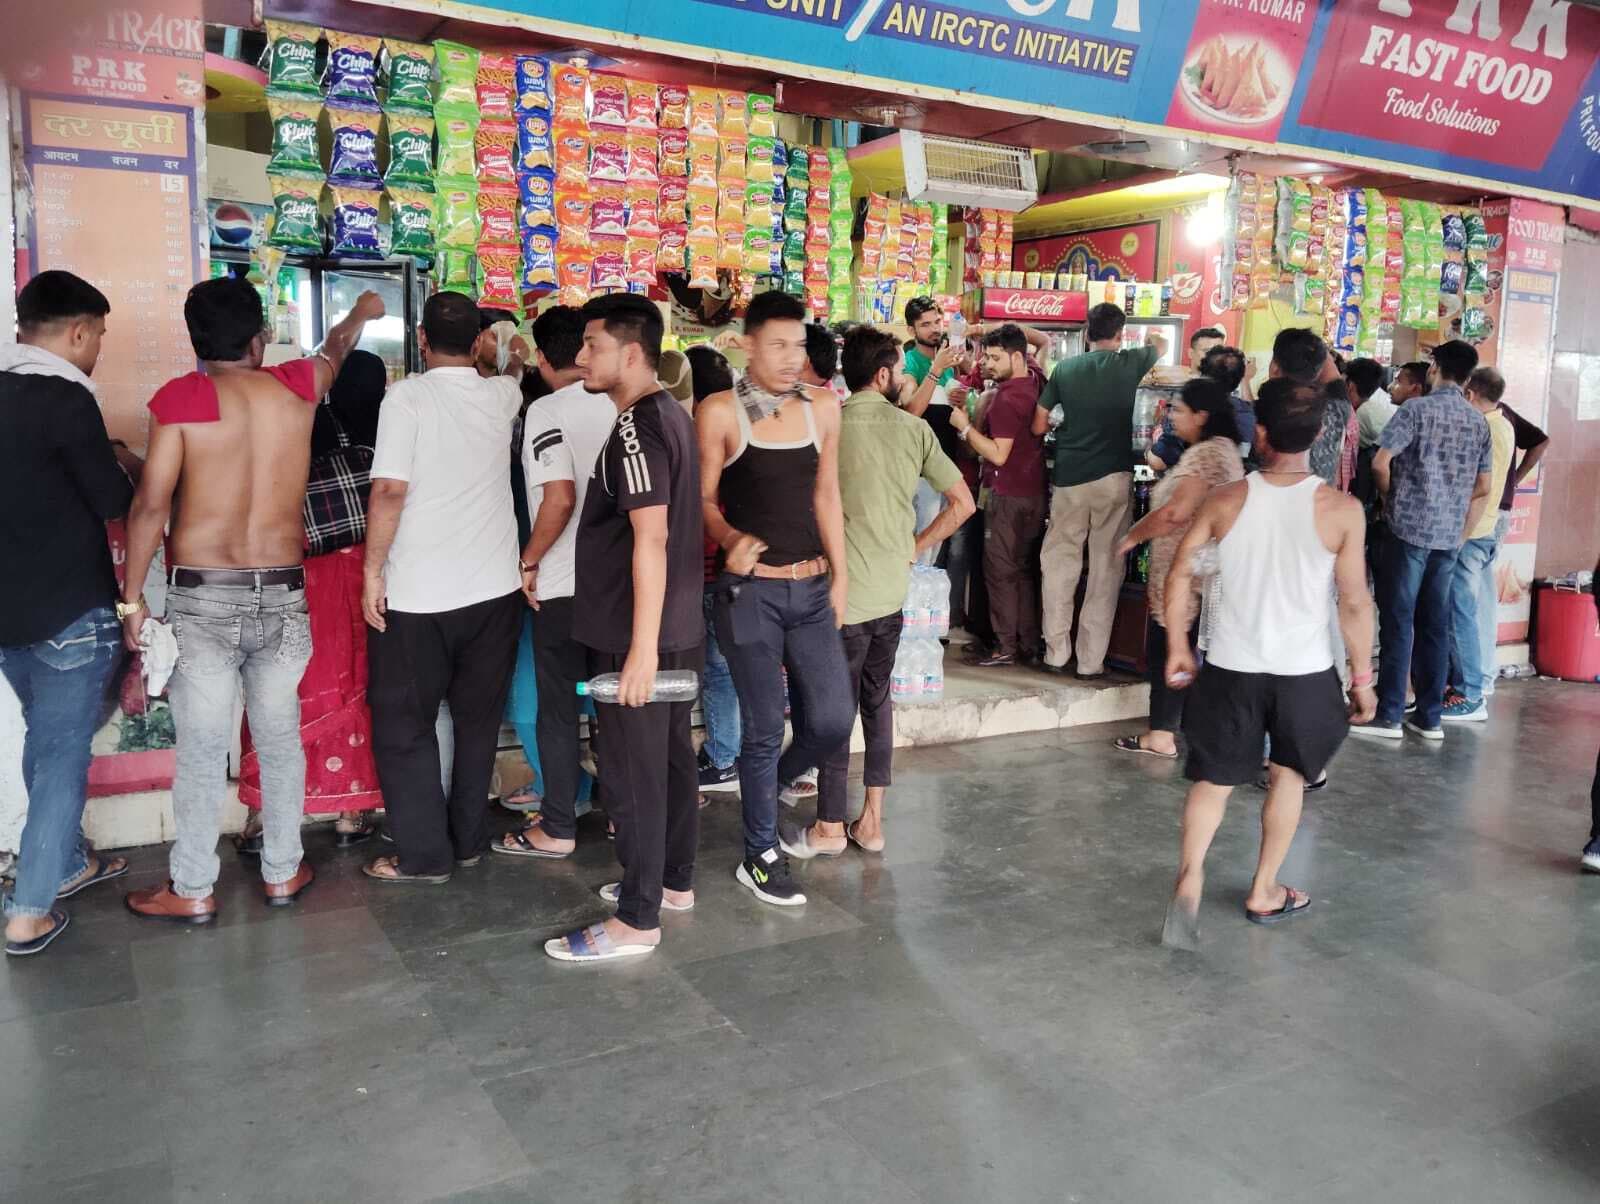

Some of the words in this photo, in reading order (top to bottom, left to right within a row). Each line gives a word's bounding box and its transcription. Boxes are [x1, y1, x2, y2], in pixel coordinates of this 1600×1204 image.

[105, 8, 204, 54] TRACK
[882, 2, 926, 36] AN
[930, 11, 1010, 52] IRCTC
[1014, 27, 1133, 77] INITIATIVE
[71, 75, 107, 89] FAST
[110, 79, 148, 93] FOOD
[1360, 25, 1460, 82] FAST
[1454, 50, 1552, 105] FOOD
[41, 113, 97, 138] दर
[101, 114, 176, 149] सूची
[1383, 87, 1430, 120] Food
[1425, 97, 1501, 136] Solutions
[1582, 124, 1600, 154] FOO
